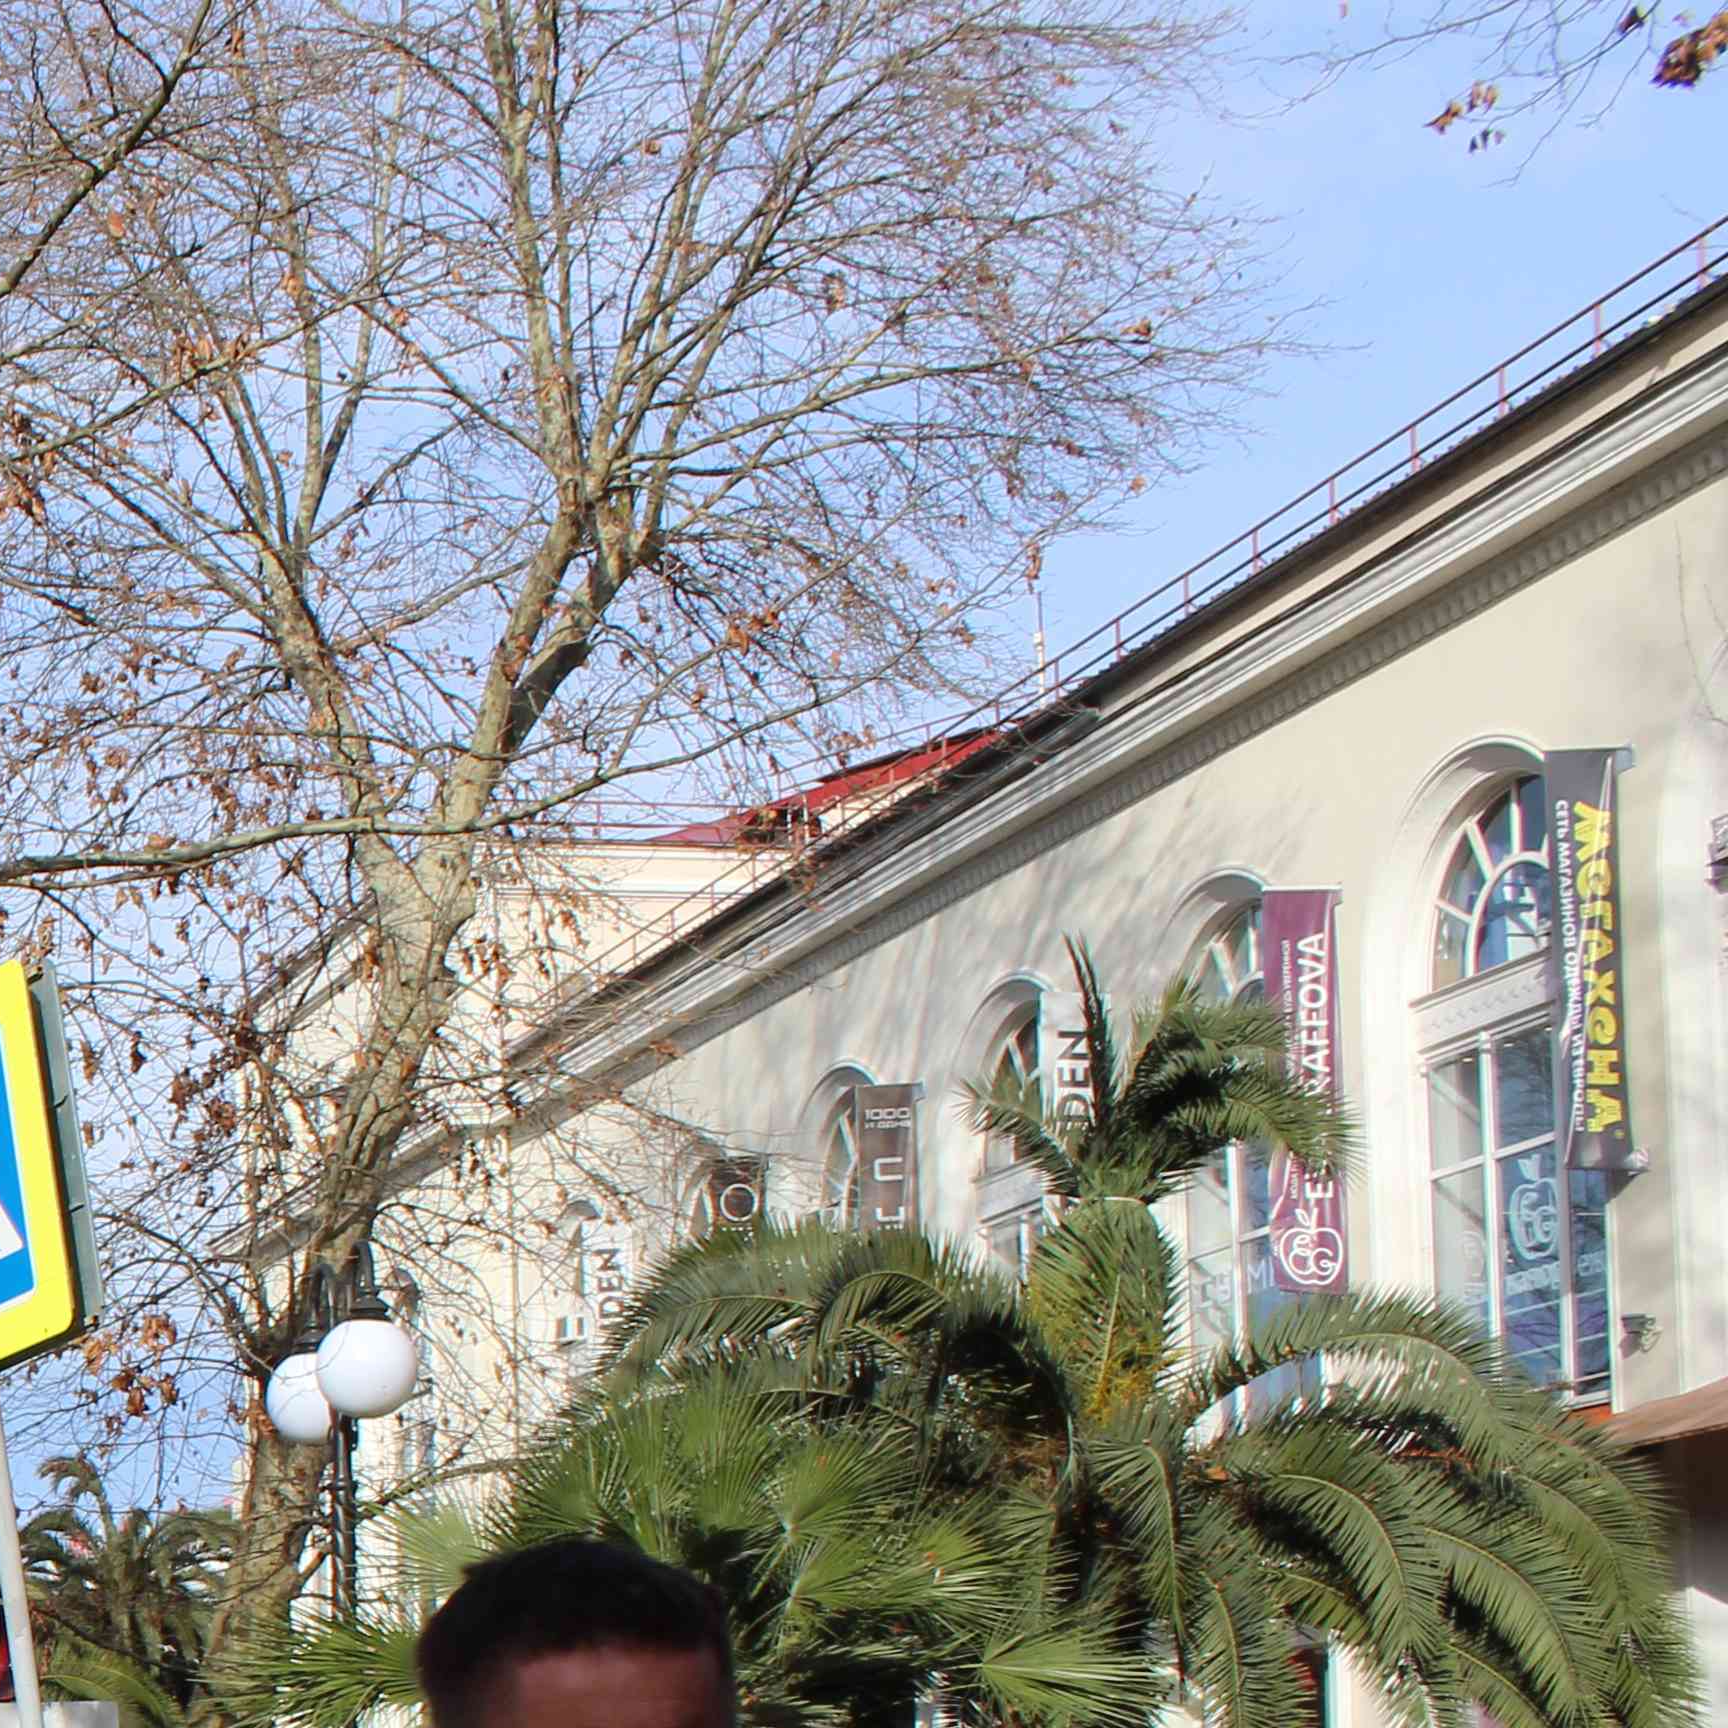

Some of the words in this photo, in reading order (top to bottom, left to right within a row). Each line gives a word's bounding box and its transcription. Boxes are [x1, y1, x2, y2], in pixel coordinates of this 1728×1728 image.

[1554, 799, 1570, 839] СЕТЬ
[1557, 842, 1576, 951] МАГАЗИНОВ
[864, 1106, 911, 1121] 1000
